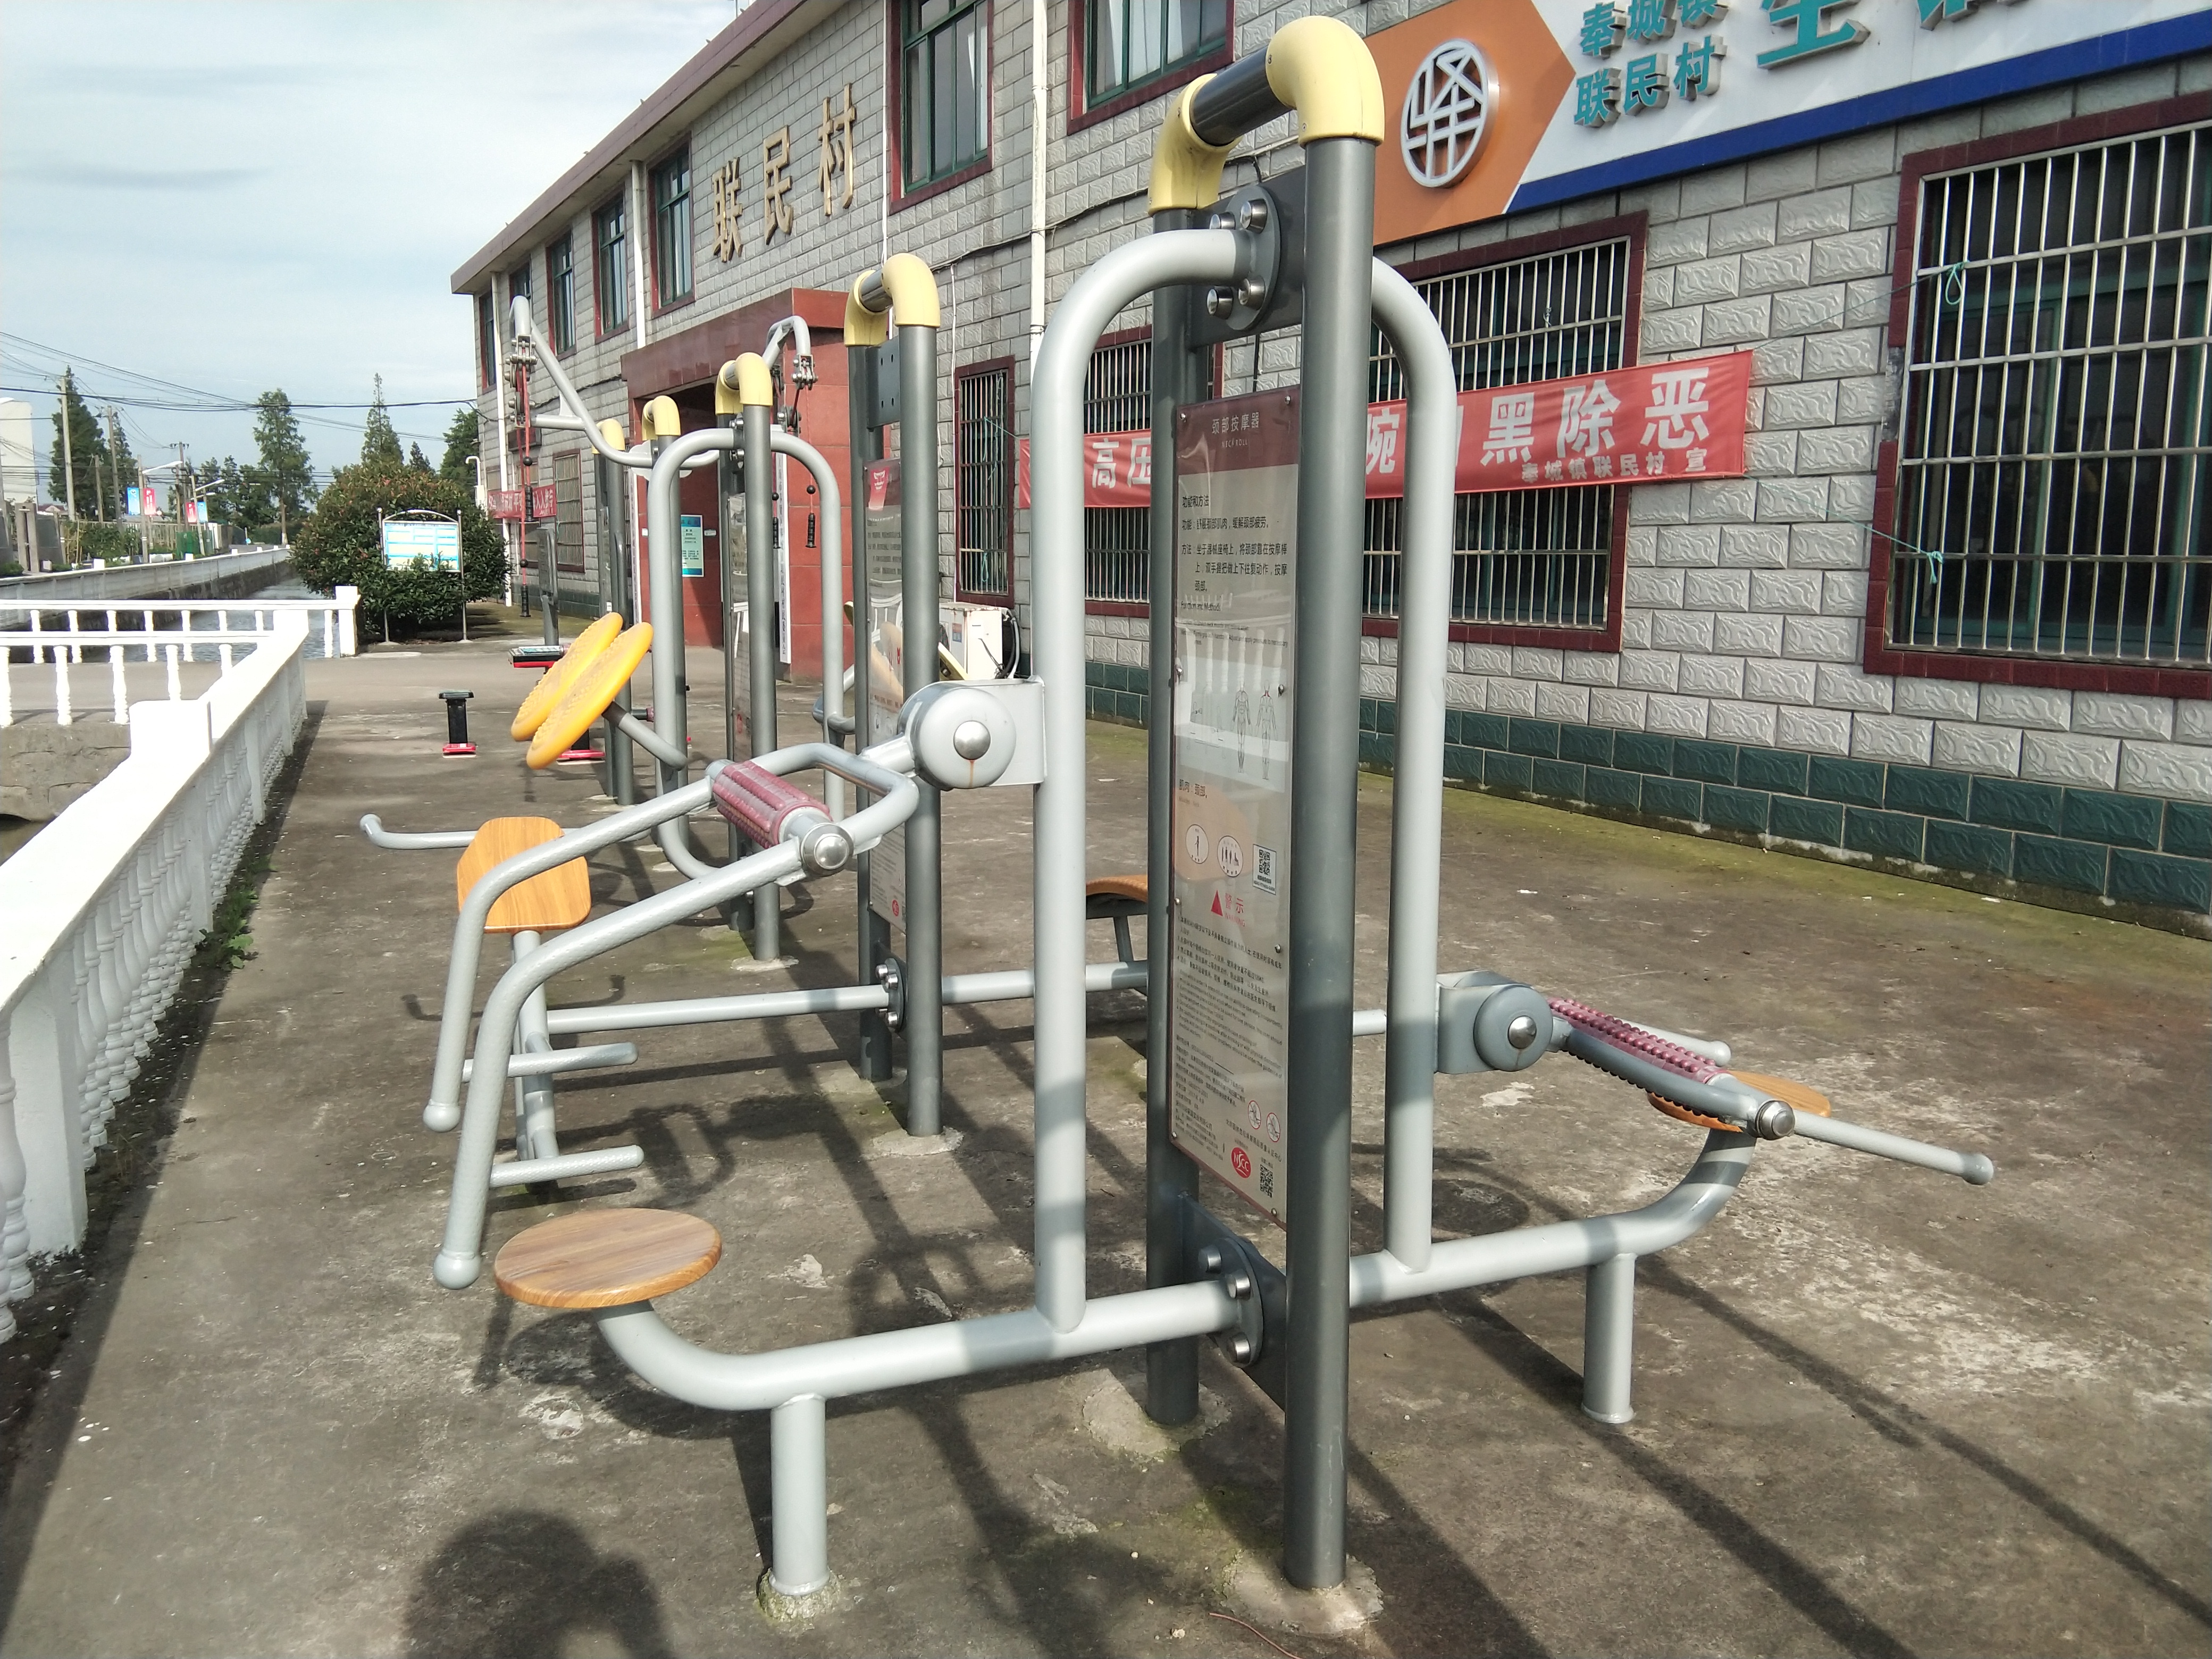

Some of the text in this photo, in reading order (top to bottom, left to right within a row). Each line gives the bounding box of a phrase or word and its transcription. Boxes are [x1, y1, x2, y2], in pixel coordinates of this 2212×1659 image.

[1574, 34, 1726, 127] 联民村
[711, 82, 856, 263] 联民村
[1212, 412, 1260, 434] 颈部按摩器
[1235, 438, 1248, 447] ROLL
[1685, 447, 1707, 472] 宣
[1182, 495, 1209, 508] 功能和方法
[1225, 893, 1244, 914] 警示
